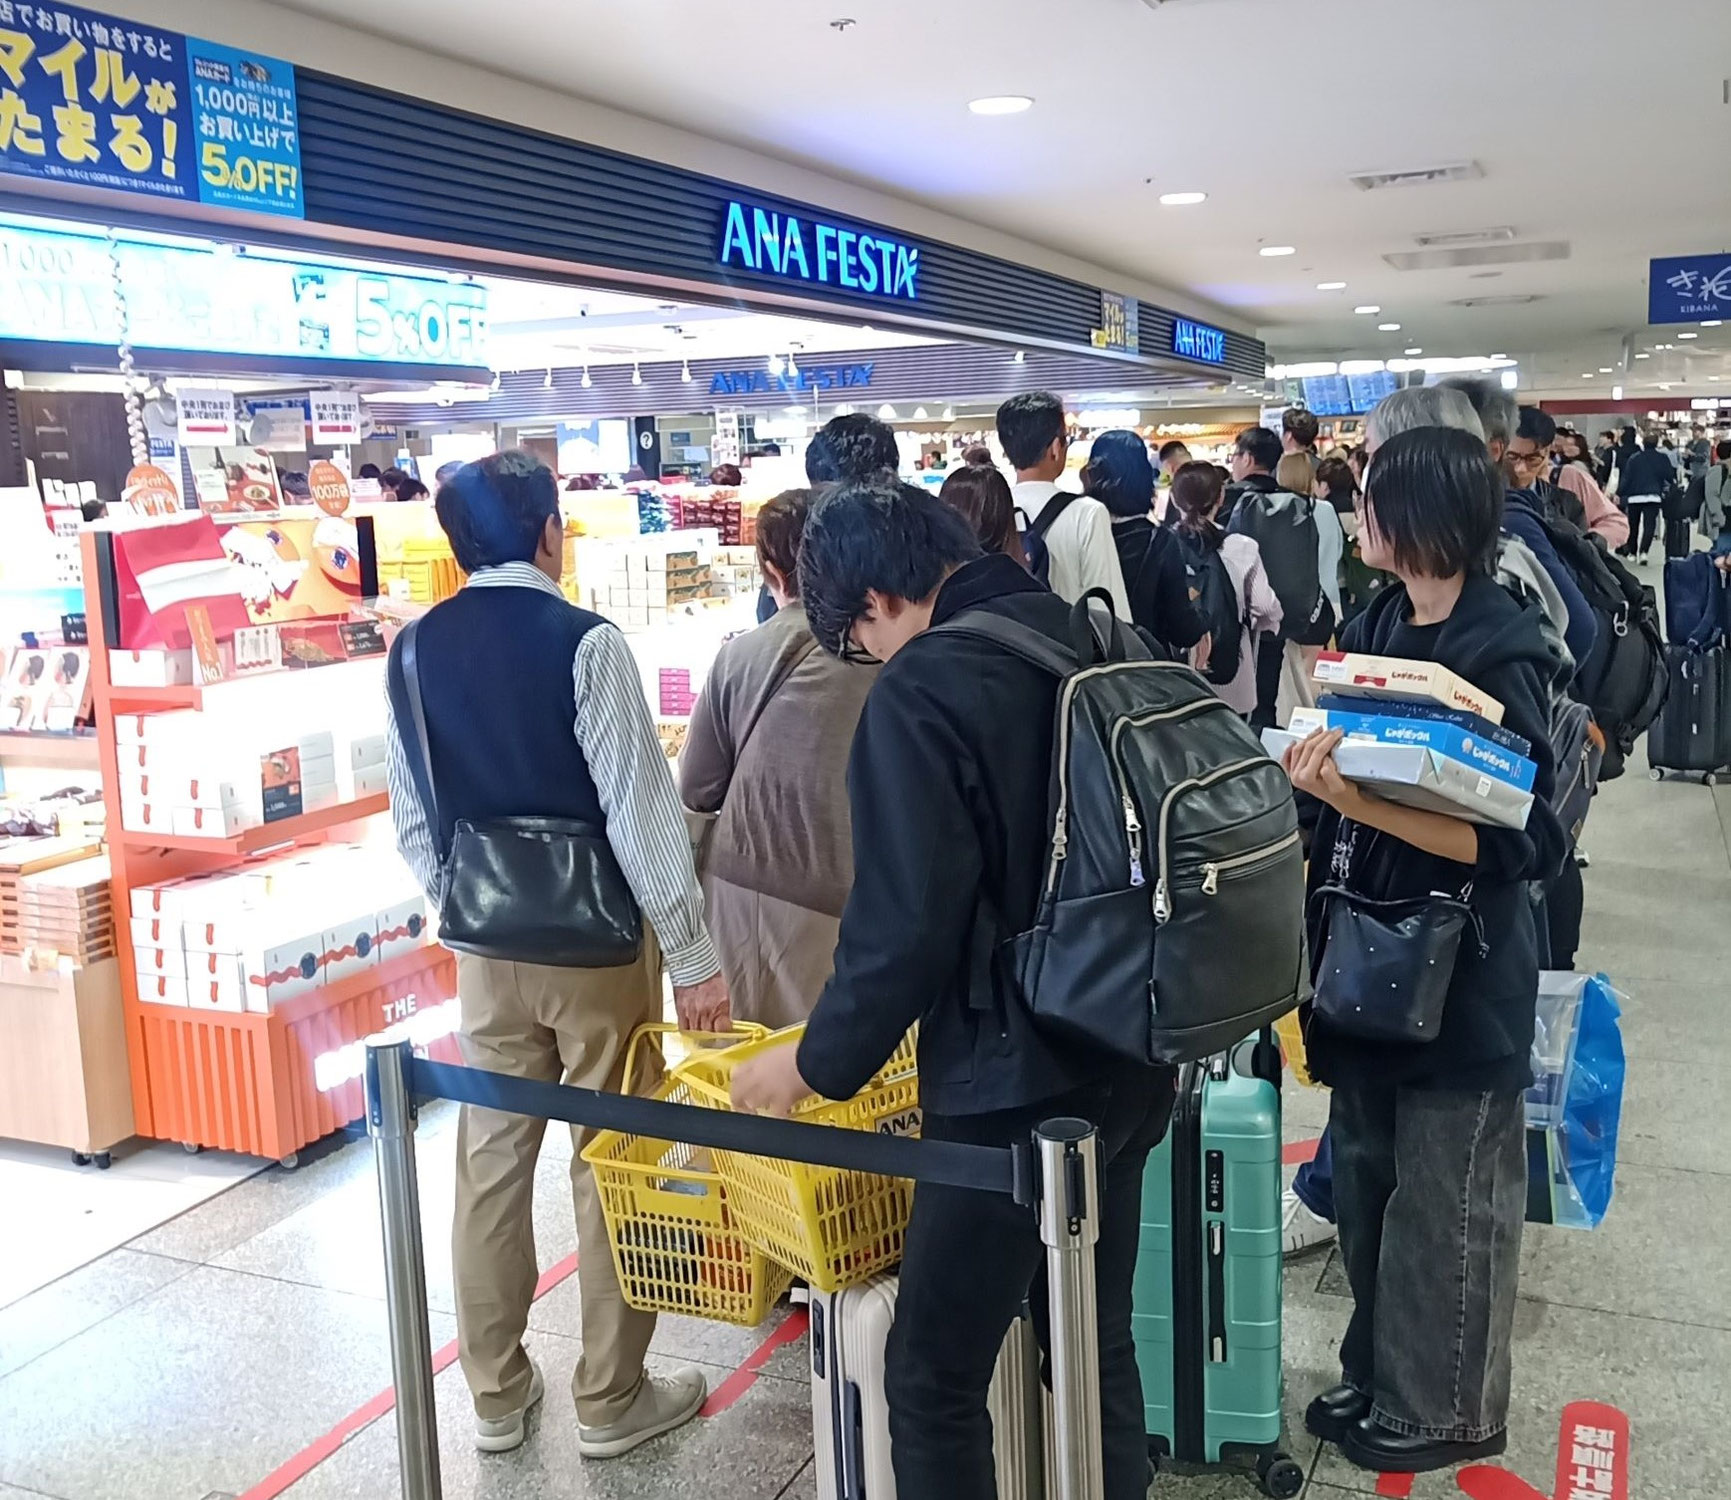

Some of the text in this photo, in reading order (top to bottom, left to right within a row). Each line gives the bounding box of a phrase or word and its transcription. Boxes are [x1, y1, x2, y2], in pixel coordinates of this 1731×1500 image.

[0, 28, 177, 116] マイルが
[200, 112, 296, 153] お買い上げで
[722, 201, 919, 299] ANA FESTA
[1174, 320, 1196, 357] ANA
[1195, 326, 1224, 362] FESTA
[709, 371, 771, 395] ANA
[381, 993, 417, 1023] THE
[878, 1111, 921, 1136] ANA
